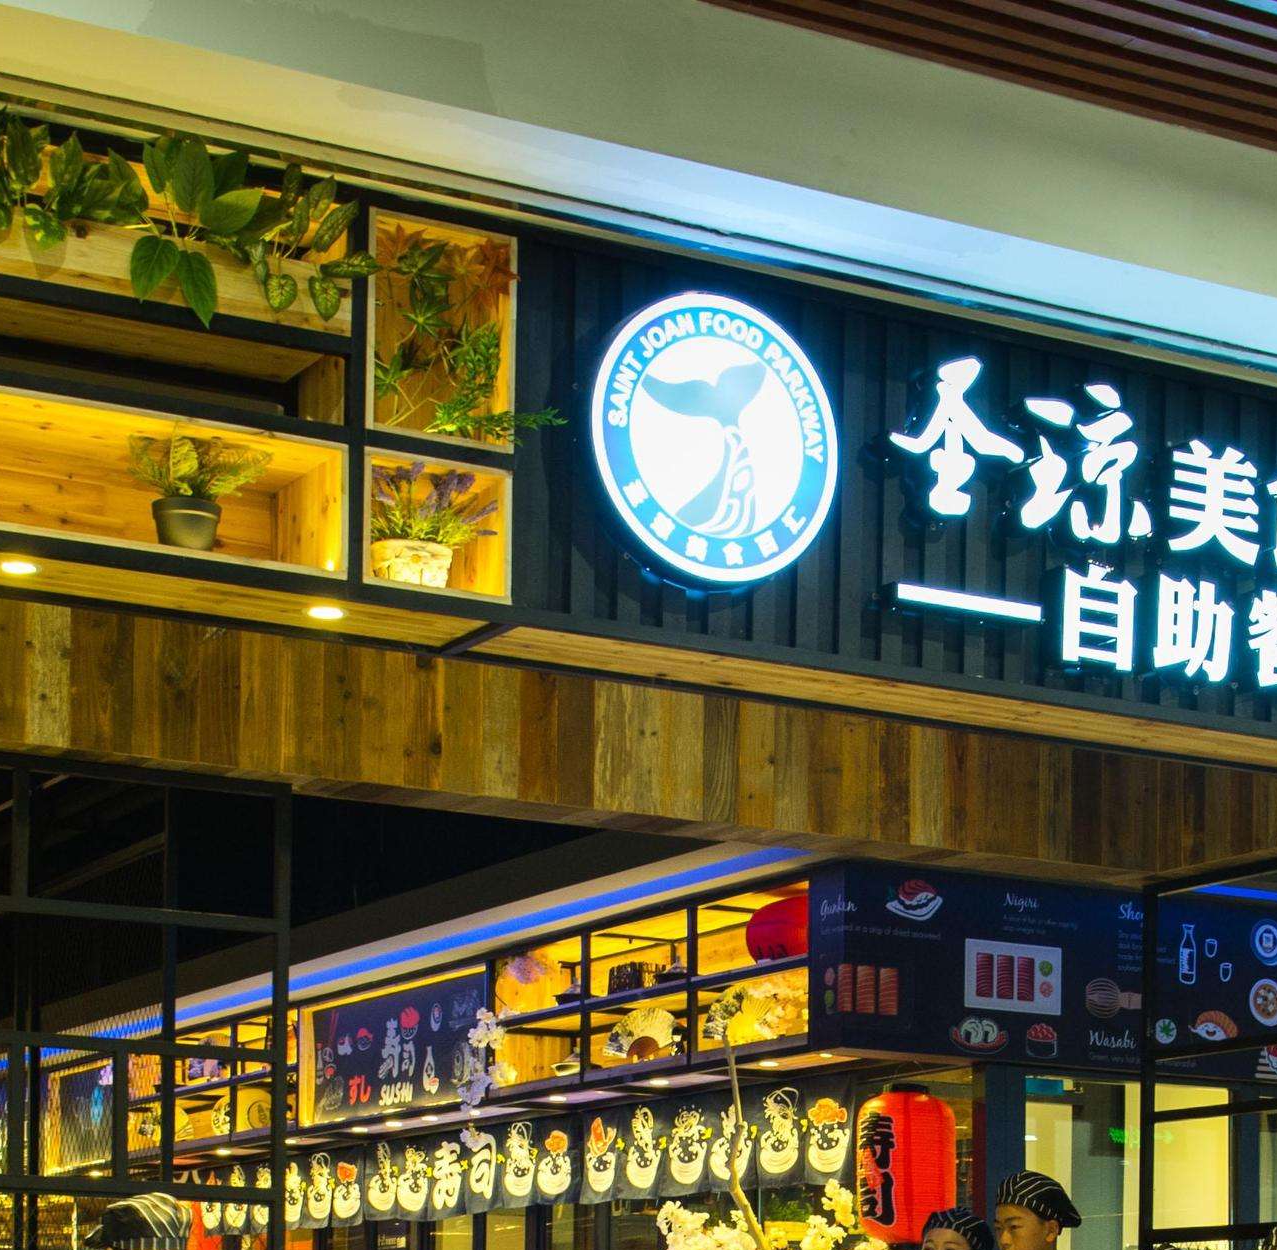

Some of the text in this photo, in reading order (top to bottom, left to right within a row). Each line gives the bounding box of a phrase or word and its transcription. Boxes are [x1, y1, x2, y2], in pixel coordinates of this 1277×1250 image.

[607, 311, 824, 464] SAINT JOAN FOOD PARKWAY
[1003, 892, 1040, 912] Nigiri
[1118, 901, 1144, 927] Sho
[1089, 1029, 1137, 1049] Wasabi
[378, 1081, 414, 1106] SUSHI
